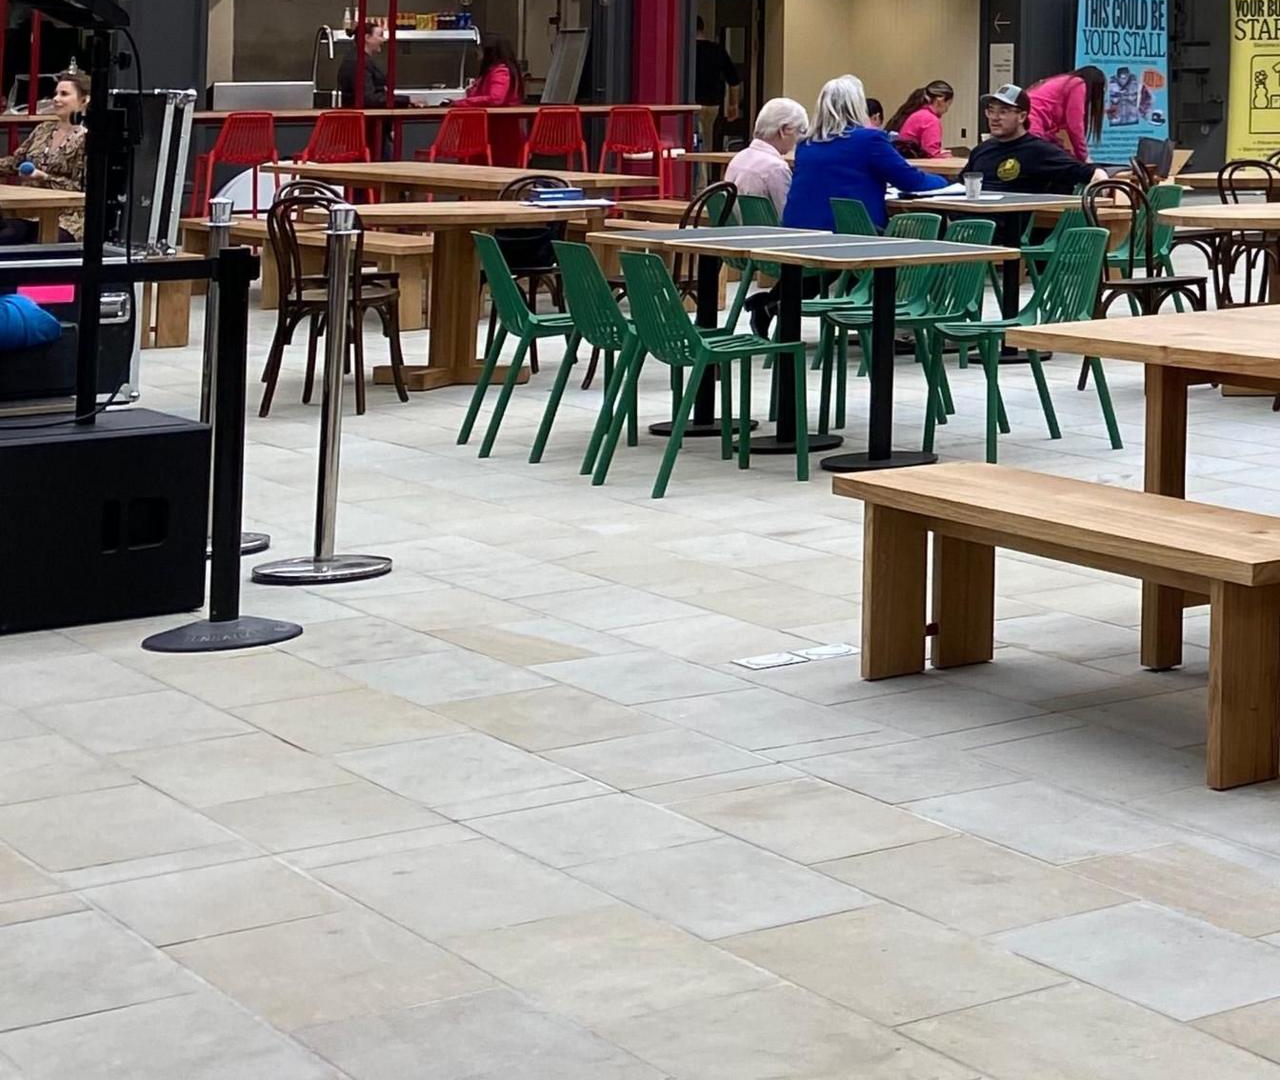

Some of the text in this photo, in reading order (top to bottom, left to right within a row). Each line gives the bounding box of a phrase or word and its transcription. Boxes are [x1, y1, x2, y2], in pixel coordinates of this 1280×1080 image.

[1151, 0, 1165, 31] BE
[1235, 0, 1265, 17] YOUR
[1083, 29, 1166, 57] YOUR STALL
